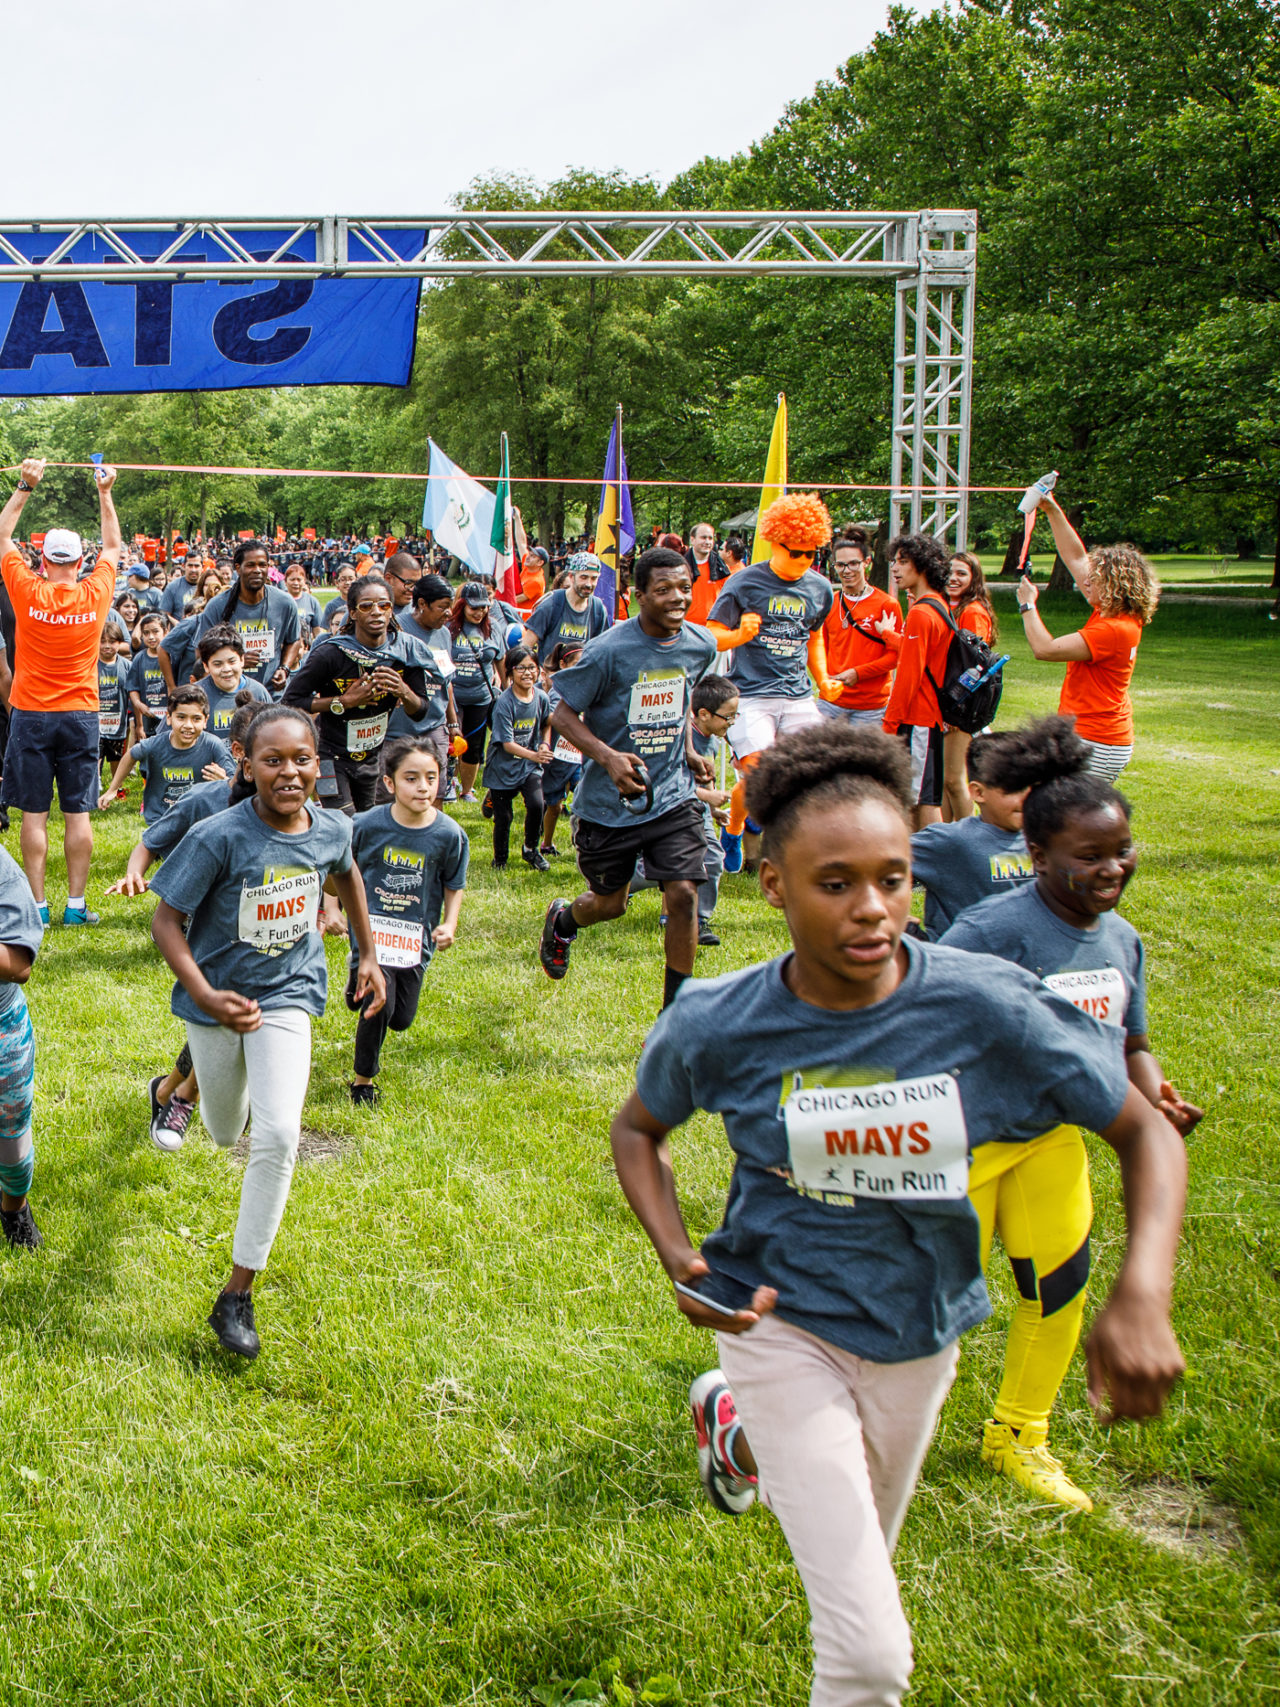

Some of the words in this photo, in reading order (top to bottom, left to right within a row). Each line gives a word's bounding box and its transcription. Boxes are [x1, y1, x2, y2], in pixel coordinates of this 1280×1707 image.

[29, 606, 96, 625] VOLUNTEER
[246, 640, 267, 648] MAYS
[636, 682, 667, 690] CHICAGO
[641, 691, 673, 707] MAYS
[662, 711, 676, 719] Run
[357, 725, 381, 739] MAYS
[247, 881, 293, 899] CHICAGO
[296, 875, 317, 888] RUN
[257, 895, 305, 921] MAYS
[269, 929, 288, 940] Fun
[292, 921, 309, 936] Run
[404, 923, 420, 931] RUN
[372, 931, 421, 952] ARDENAS
[381, 953, 395, 963] Fun
[1051, 974, 1098, 989] CHICAGO
[797, 1090, 896, 1113] CHICAGO
[904, 1082, 947, 1104] RUN
[824, 1120, 932, 1157] MAYS
[852, 1168, 894, 1193] Fun
[902, 1170, 947, 1192] Run
